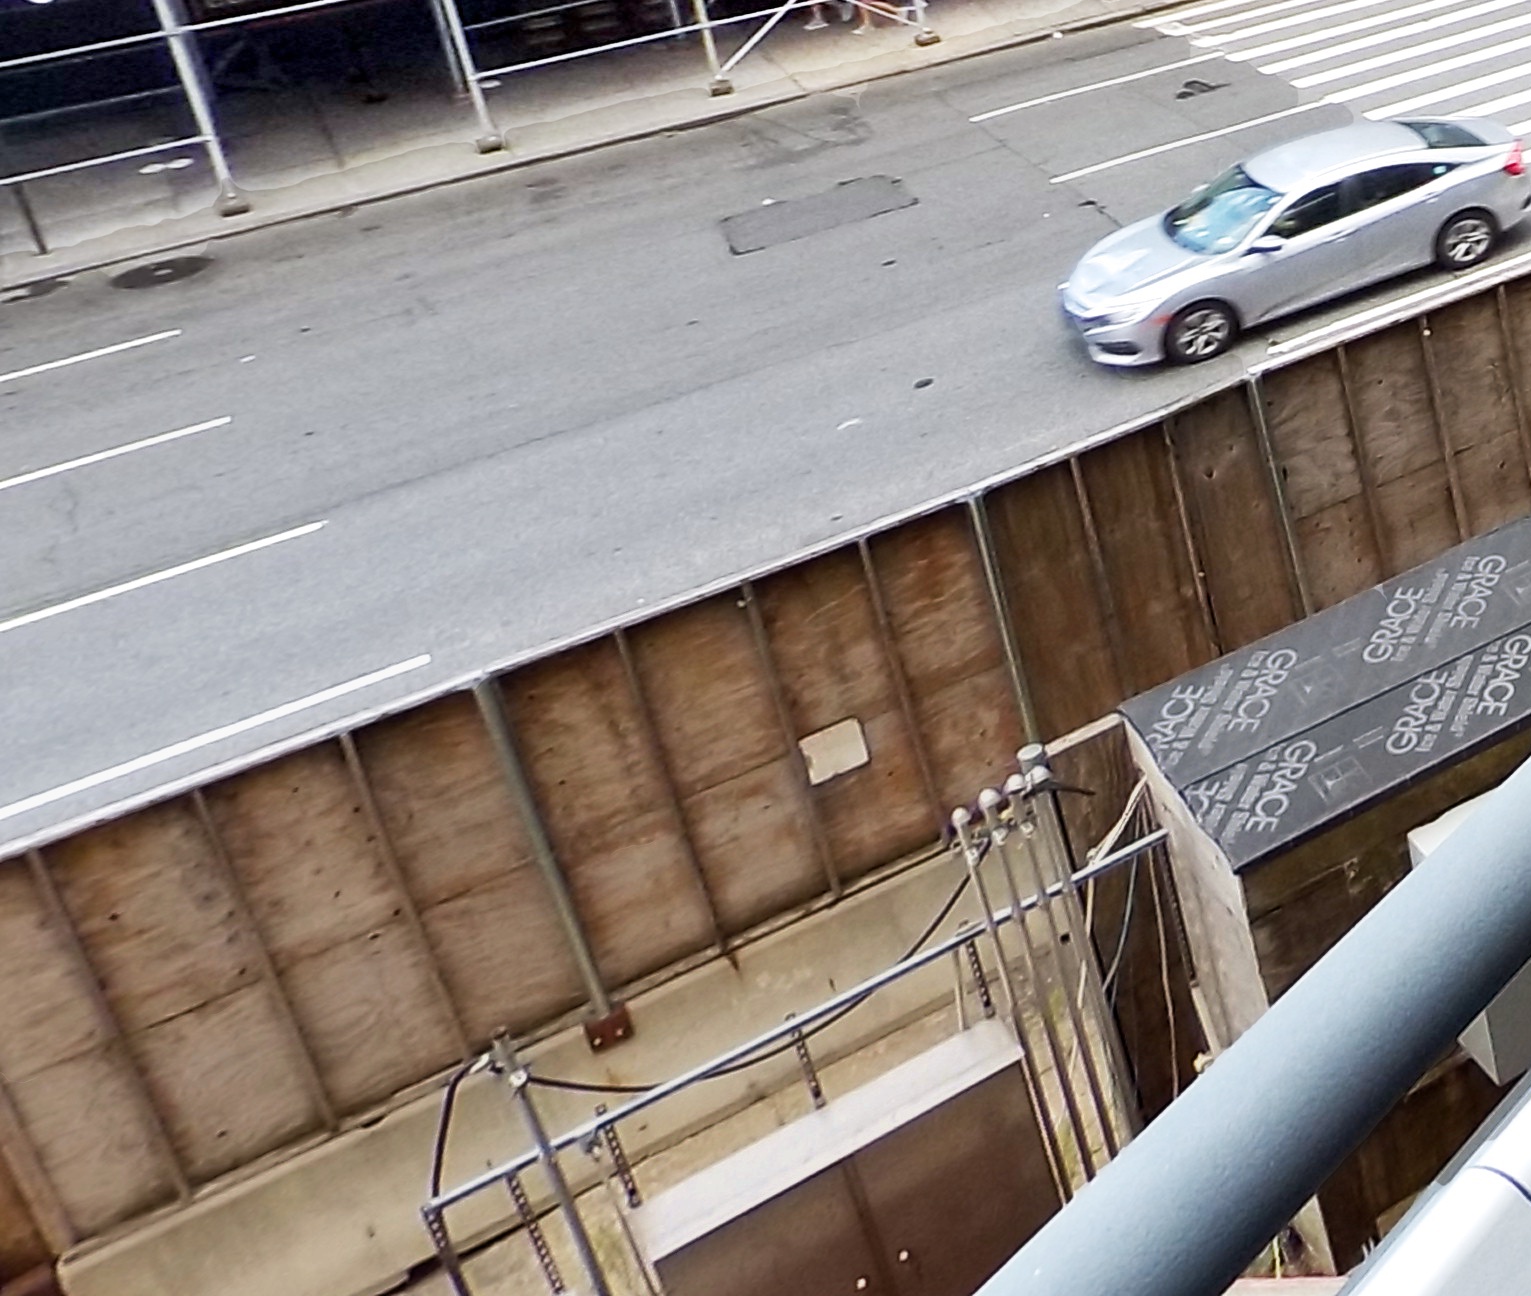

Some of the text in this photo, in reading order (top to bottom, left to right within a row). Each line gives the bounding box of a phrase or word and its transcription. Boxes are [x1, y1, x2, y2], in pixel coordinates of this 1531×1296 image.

[1362, 587, 1424, 663] GRACE
[1449, 555, 1507, 629] GRACE
[1227, 649, 1297, 733] GRACE
[1385, 670, 1449, 754] GRACE
[1244, 740, 1317, 832] GRACE
